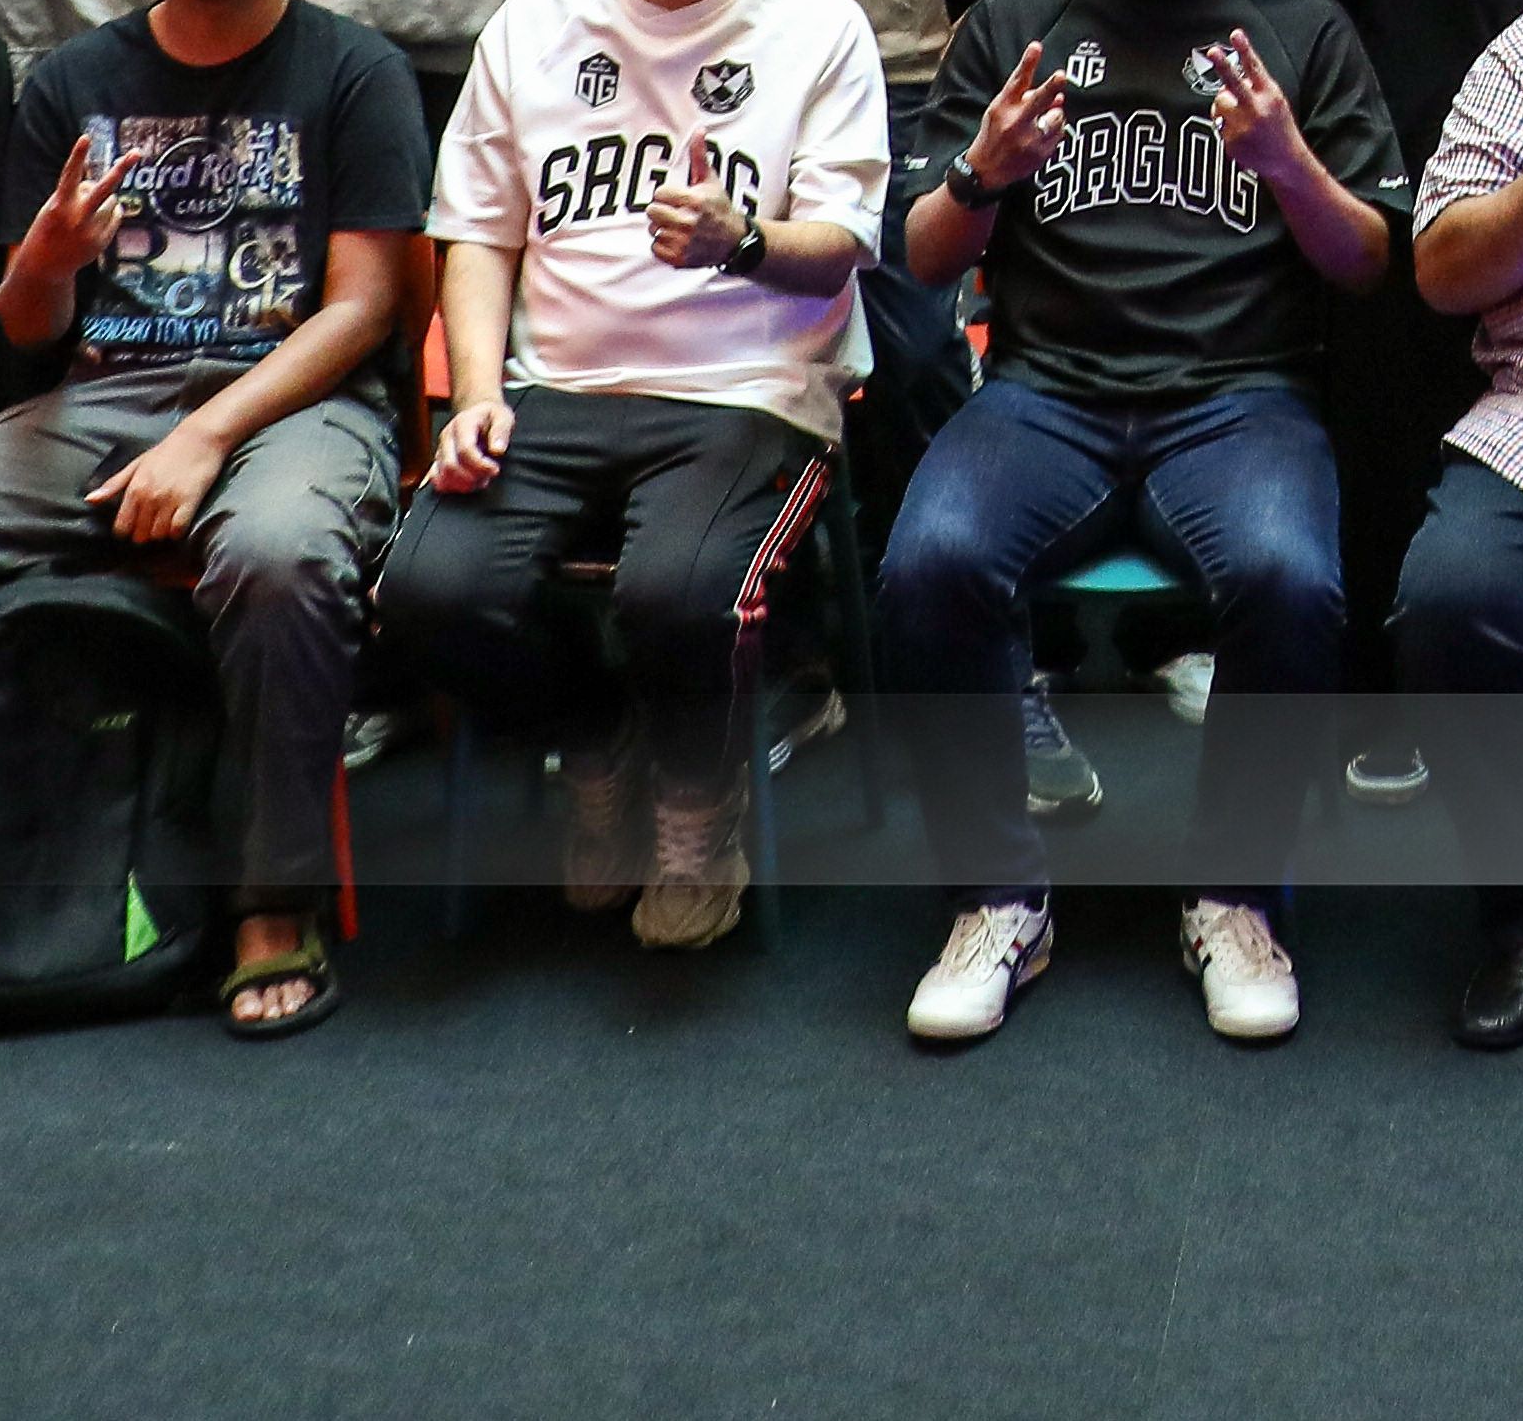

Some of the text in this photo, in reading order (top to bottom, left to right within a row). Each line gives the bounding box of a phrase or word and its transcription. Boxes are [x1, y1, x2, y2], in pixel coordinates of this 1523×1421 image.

[199, 152, 274, 195] Rock
[175, 198, 219, 215] CAFE
[154, 315, 221, 344] TOKYO
